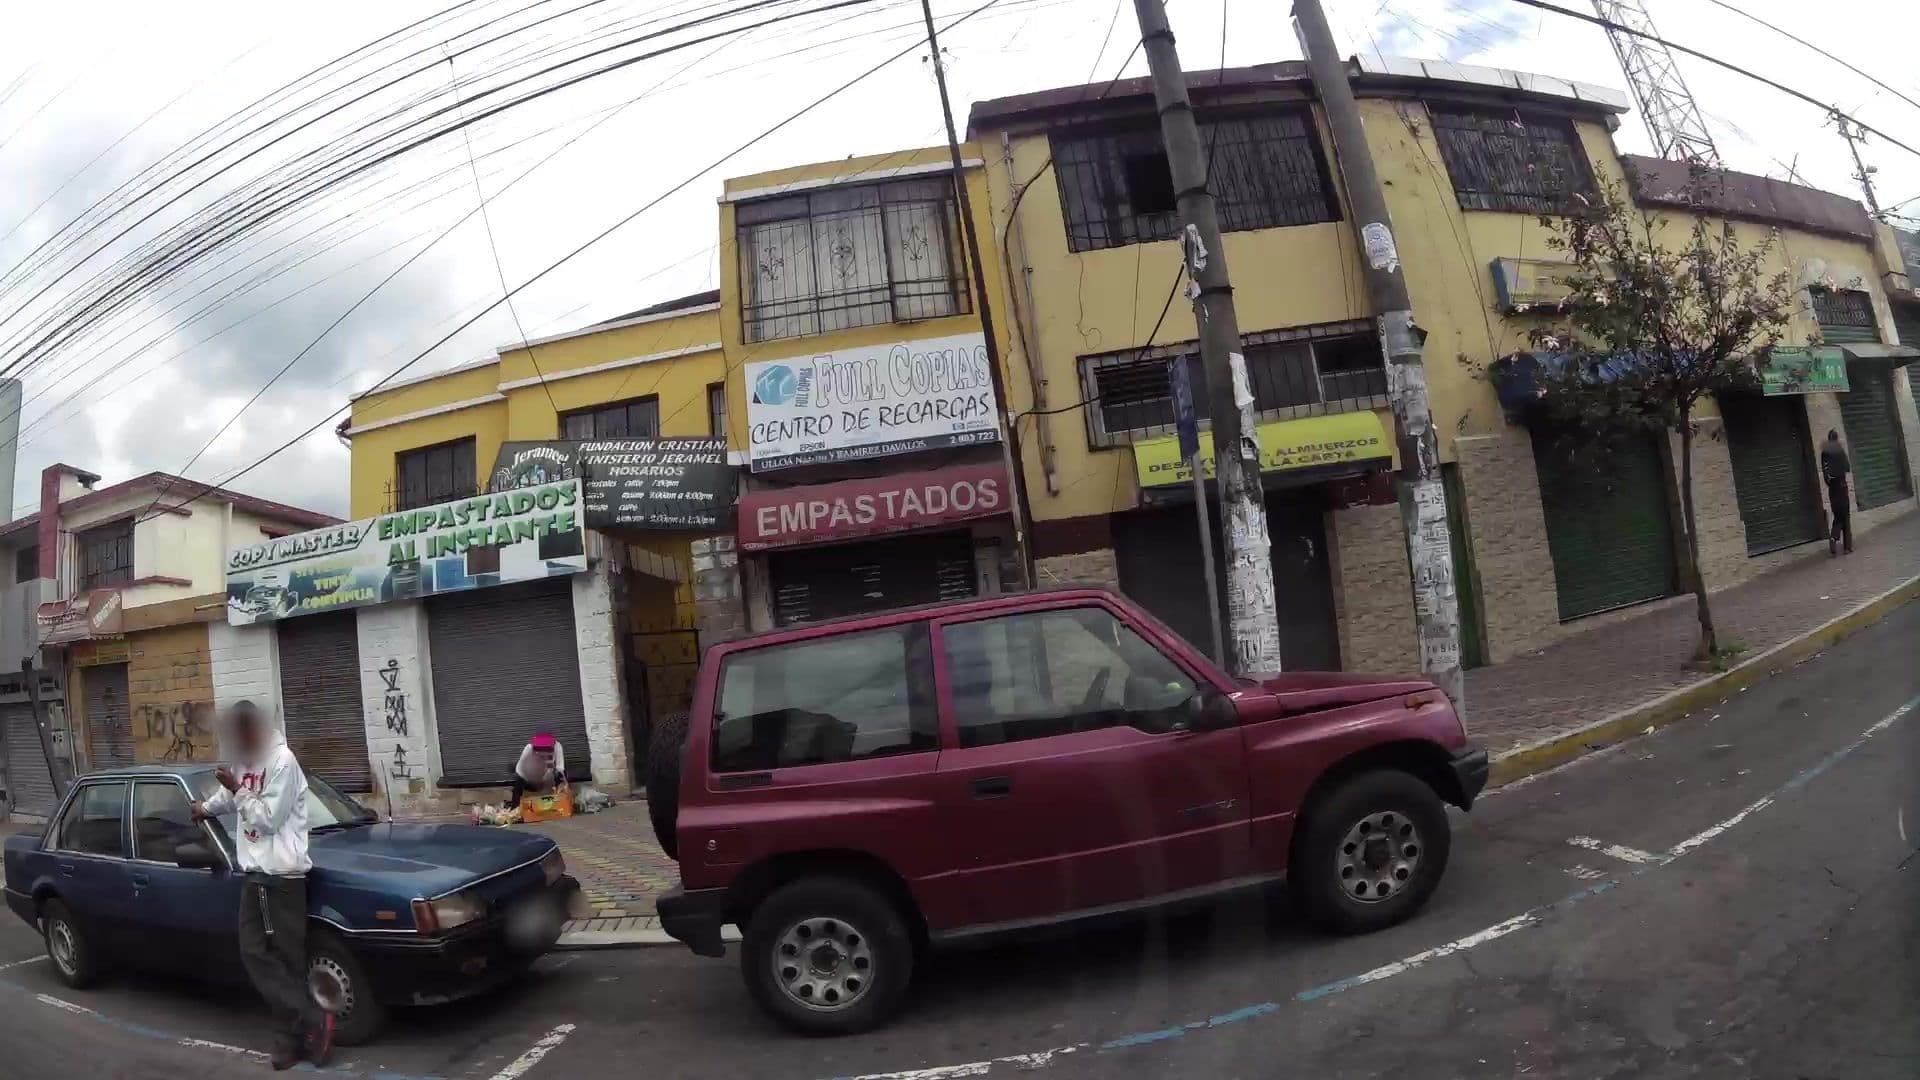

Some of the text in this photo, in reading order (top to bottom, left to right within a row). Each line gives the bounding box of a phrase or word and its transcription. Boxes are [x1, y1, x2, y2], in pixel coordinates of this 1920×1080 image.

[812, 344, 993, 408] FULL COPIAS
[751, 413, 834, 445] CENTRO
[841, 407, 870, 433] DE
[878, 392, 990, 427] RECARGAS
[577, 453, 722, 465] INISTERIO JERAMEL
[579, 441, 654, 451] FUNDACION
[760, 457, 794, 470] ULLOA
[881, 439, 927, 453] DAVALOS
[1276, 437, 1379, 457] ALMUERZOS
[608, 466, 686, 477] HORARIOS
[377, 481, 578, 541] EMPASTADOS
[756, 478, 999, 537] EMPASTADOS
[230, 541, 277, 568] COPY
[279, 526, 361, 558] MASTER
[387, 540, 421, 567] AL
[426, 511, 577, 559] INSTANTE
